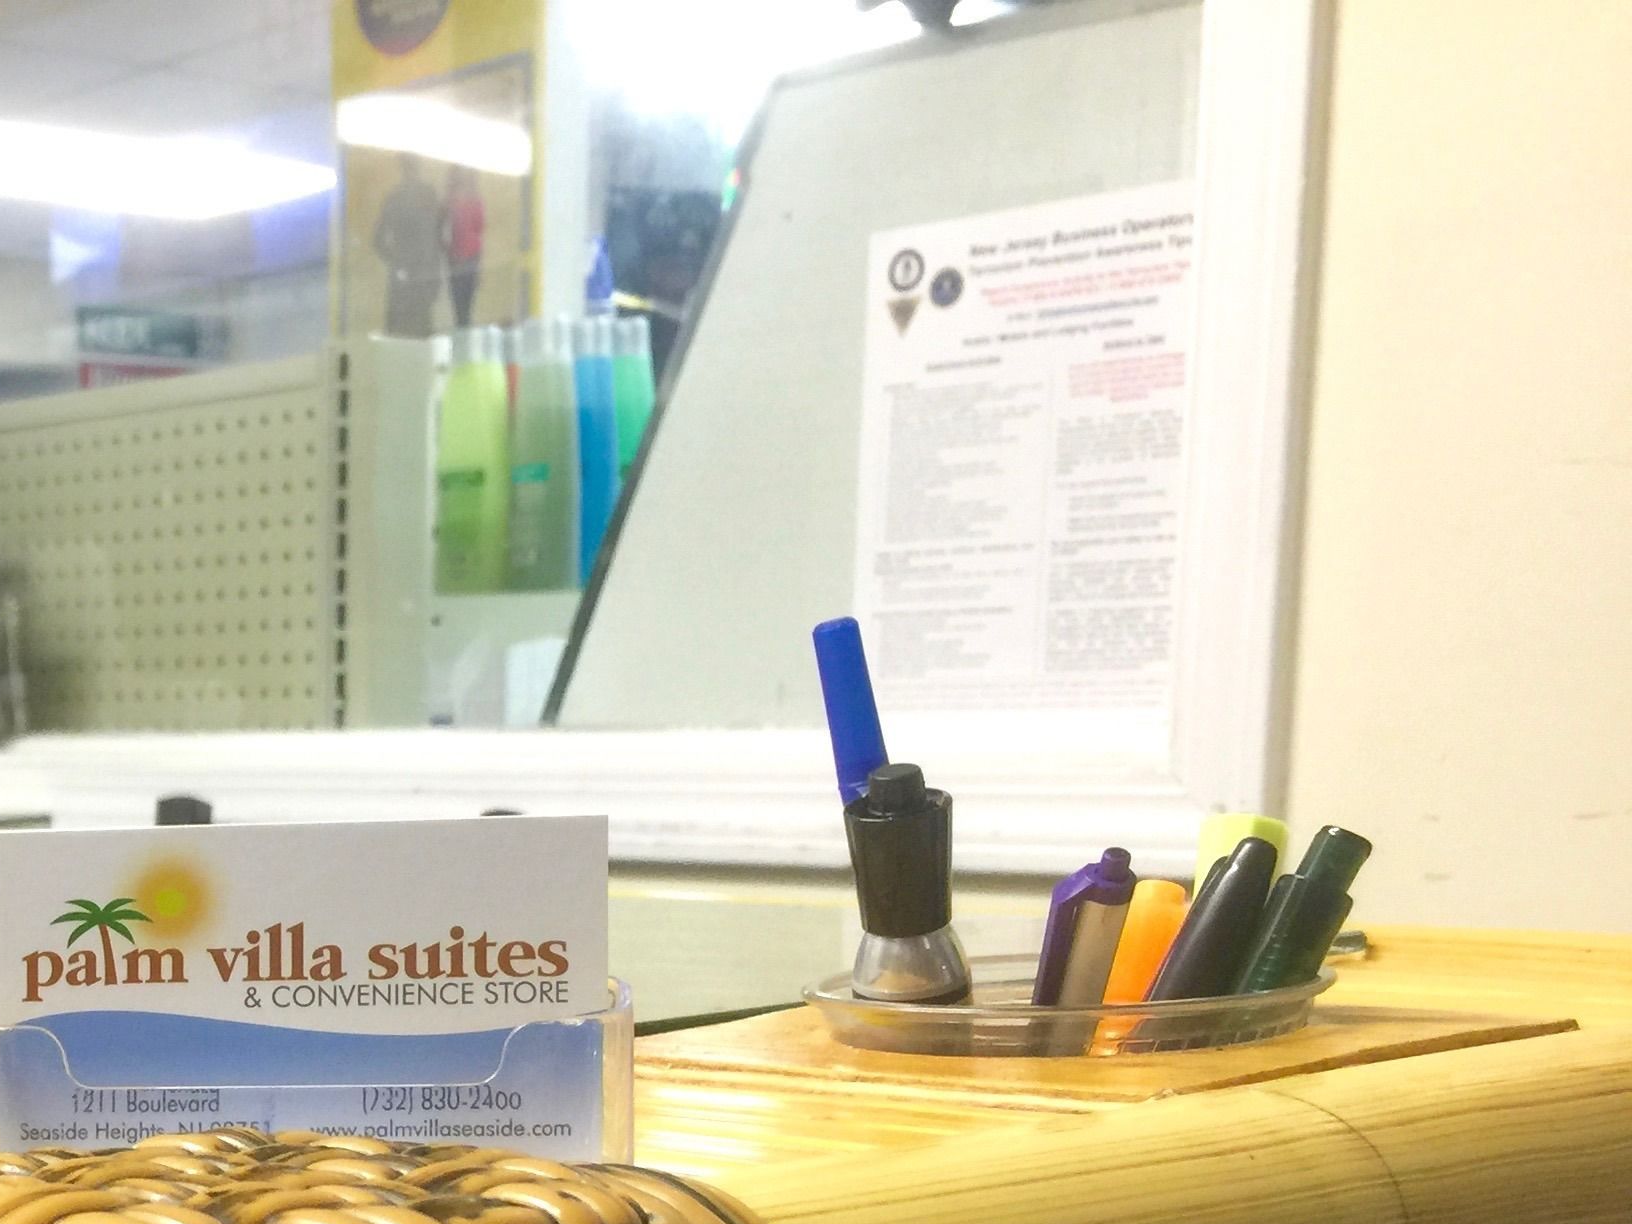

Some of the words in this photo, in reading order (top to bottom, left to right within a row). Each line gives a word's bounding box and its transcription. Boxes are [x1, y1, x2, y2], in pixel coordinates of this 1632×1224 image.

[1052, 224, 1118, 247] Business
[22, 924, 188, 1002] palm
[206, 921, 347, 983] villa
[368, 925, 569, 980] suites
[244, 986, 262, 1009] &
[272, 982, 474, 1009] CONVENIENCE
[484, 980, 569, 1004] STORE
[126, 1089, 220, 1113] Boulevard
[20, 1122, 88, 1142] Seaside
